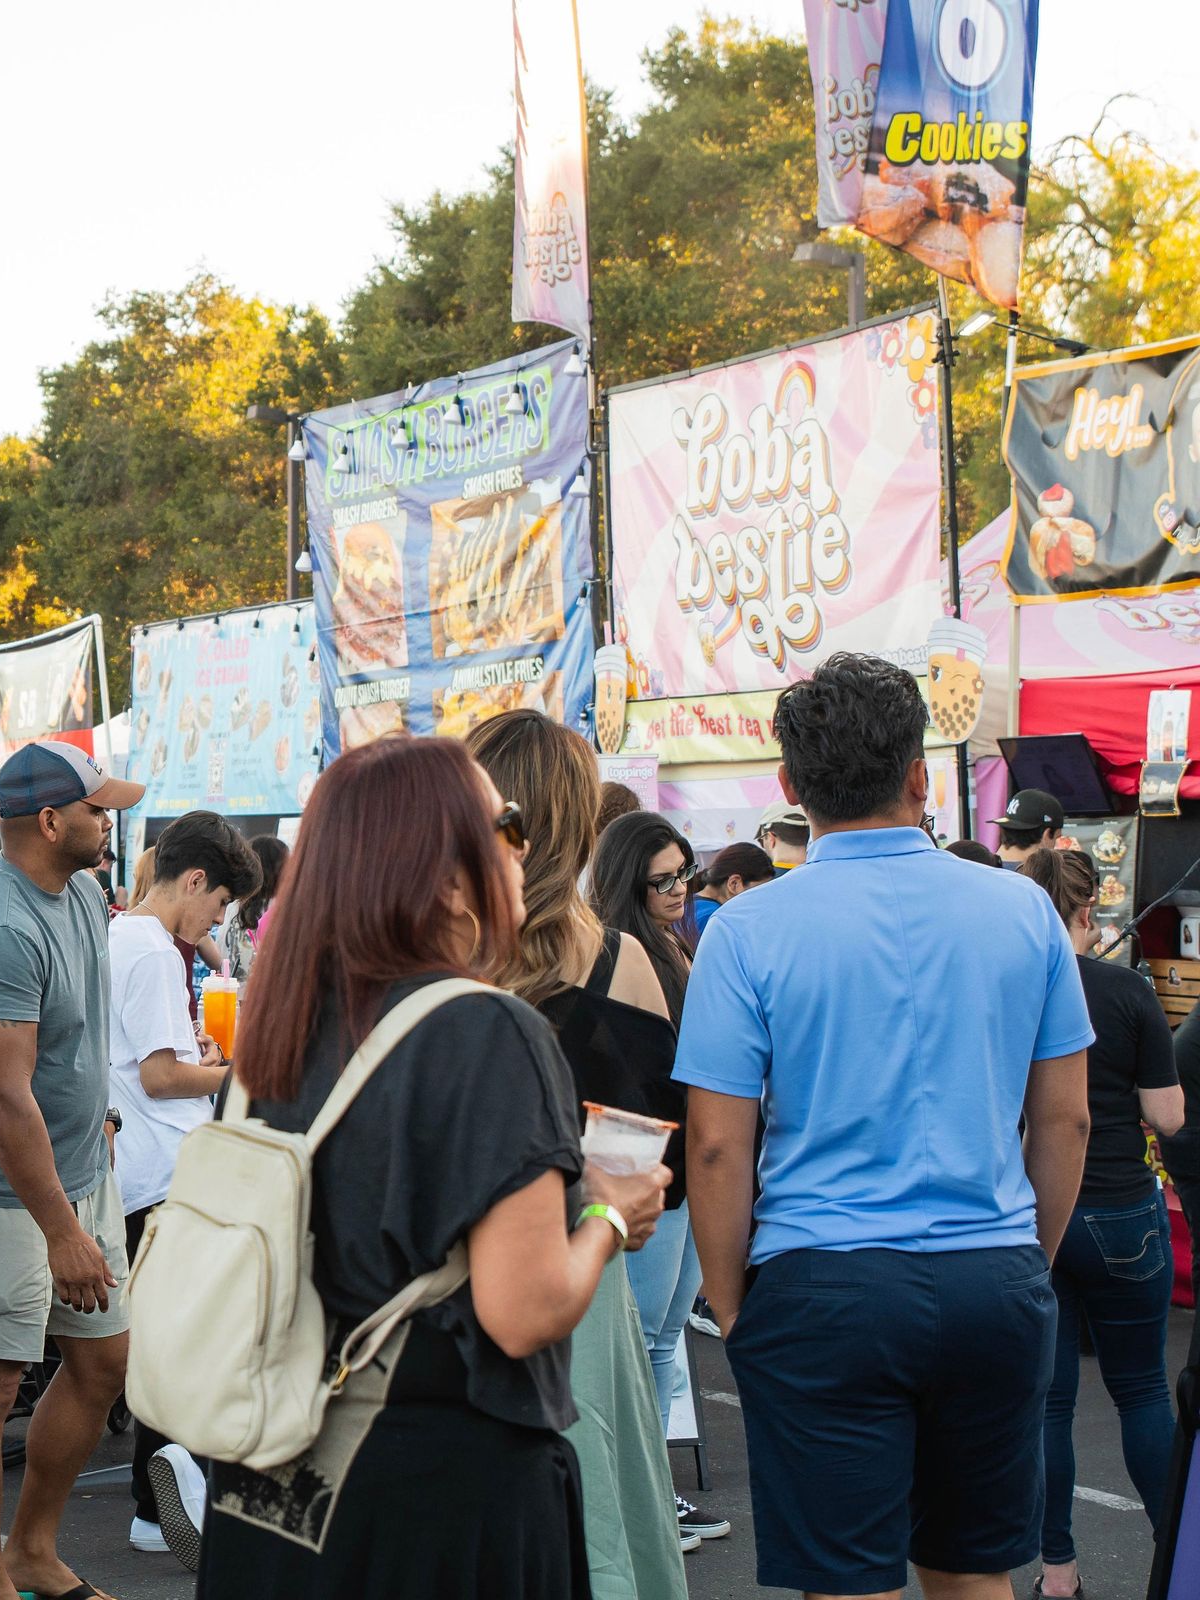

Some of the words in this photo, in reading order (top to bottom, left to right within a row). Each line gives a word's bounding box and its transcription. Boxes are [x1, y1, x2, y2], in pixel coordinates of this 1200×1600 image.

[885, 111, 1030, 166] Cookies
[671, 392, 841, 522] boba
[463, 475, 495, 500] SMASH
[496, 464, 523, 491] FRIES
[332, 504, 360, 528] SMASH
[360, 495, 399, 523] BURGERS
[672, 502, 851, 614] bestie
[513, 657, 544, 683] FRIES
[644, 717, 666, 751] get
[669, 703, 695, 737] the
[692, 703, 732, 736] best
[738, 714, 765, 745] tea
[608, 767, 654, 780] toppings
